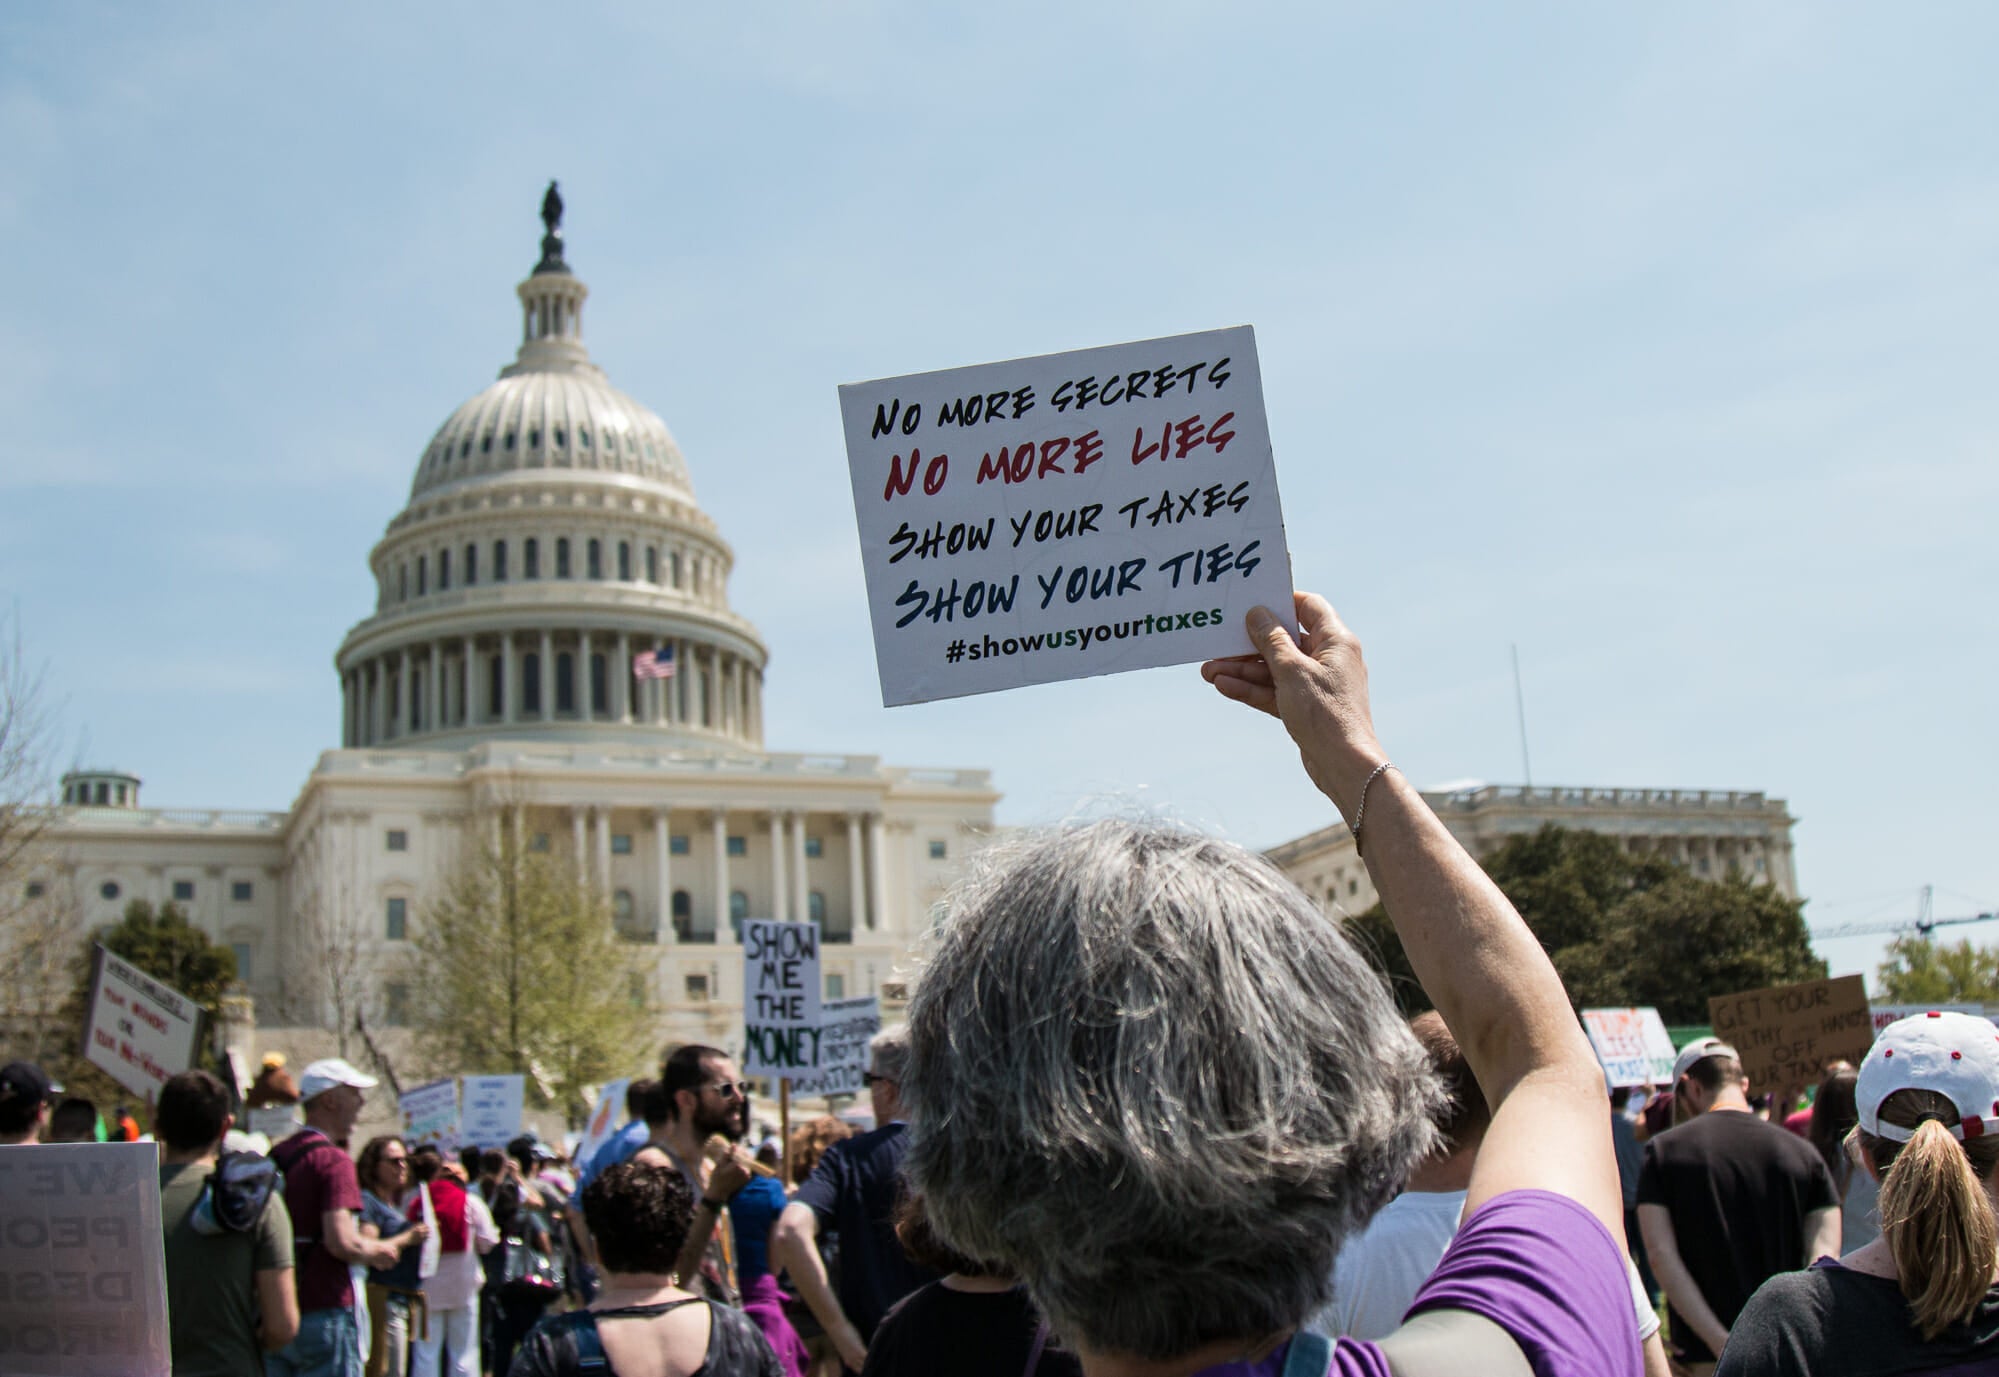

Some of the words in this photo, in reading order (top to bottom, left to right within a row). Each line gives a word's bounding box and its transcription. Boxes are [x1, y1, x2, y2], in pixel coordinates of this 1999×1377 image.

[871, 398, 921, 439] NO
[937, 384, 1036, 428] MORE
[1050, 356, 1232, 414] SECRETS
[883, 447, 949, 503] NO
[976, 429, 1104, 485] MORE
[1131, 411, 1236, 466] LIES
[888, 517, 996, 565] SHOW
[1009, 503, 1104, 549] YOUR
[1117, 480, 1251, 529] TAXES
[894, 574, 1020, 630] SHOW
[1037, 557, 1147, 610] YOUR
[1157, 539, 1262, 589] TIES
[945, 607, 1224, 664] #showusyourtaxes
[747, 924, 815, 960] SHOW
[759, 961, 803, 990] ME
[755, 994, 804, 1020] THE
[1716, 997, 1762, 1030] GET
[1771, 985, 1831, 1014] YOUR
[744, 1024, 822, 1068] MONEY
[1772, 1038, 1818, 1063] OFF
